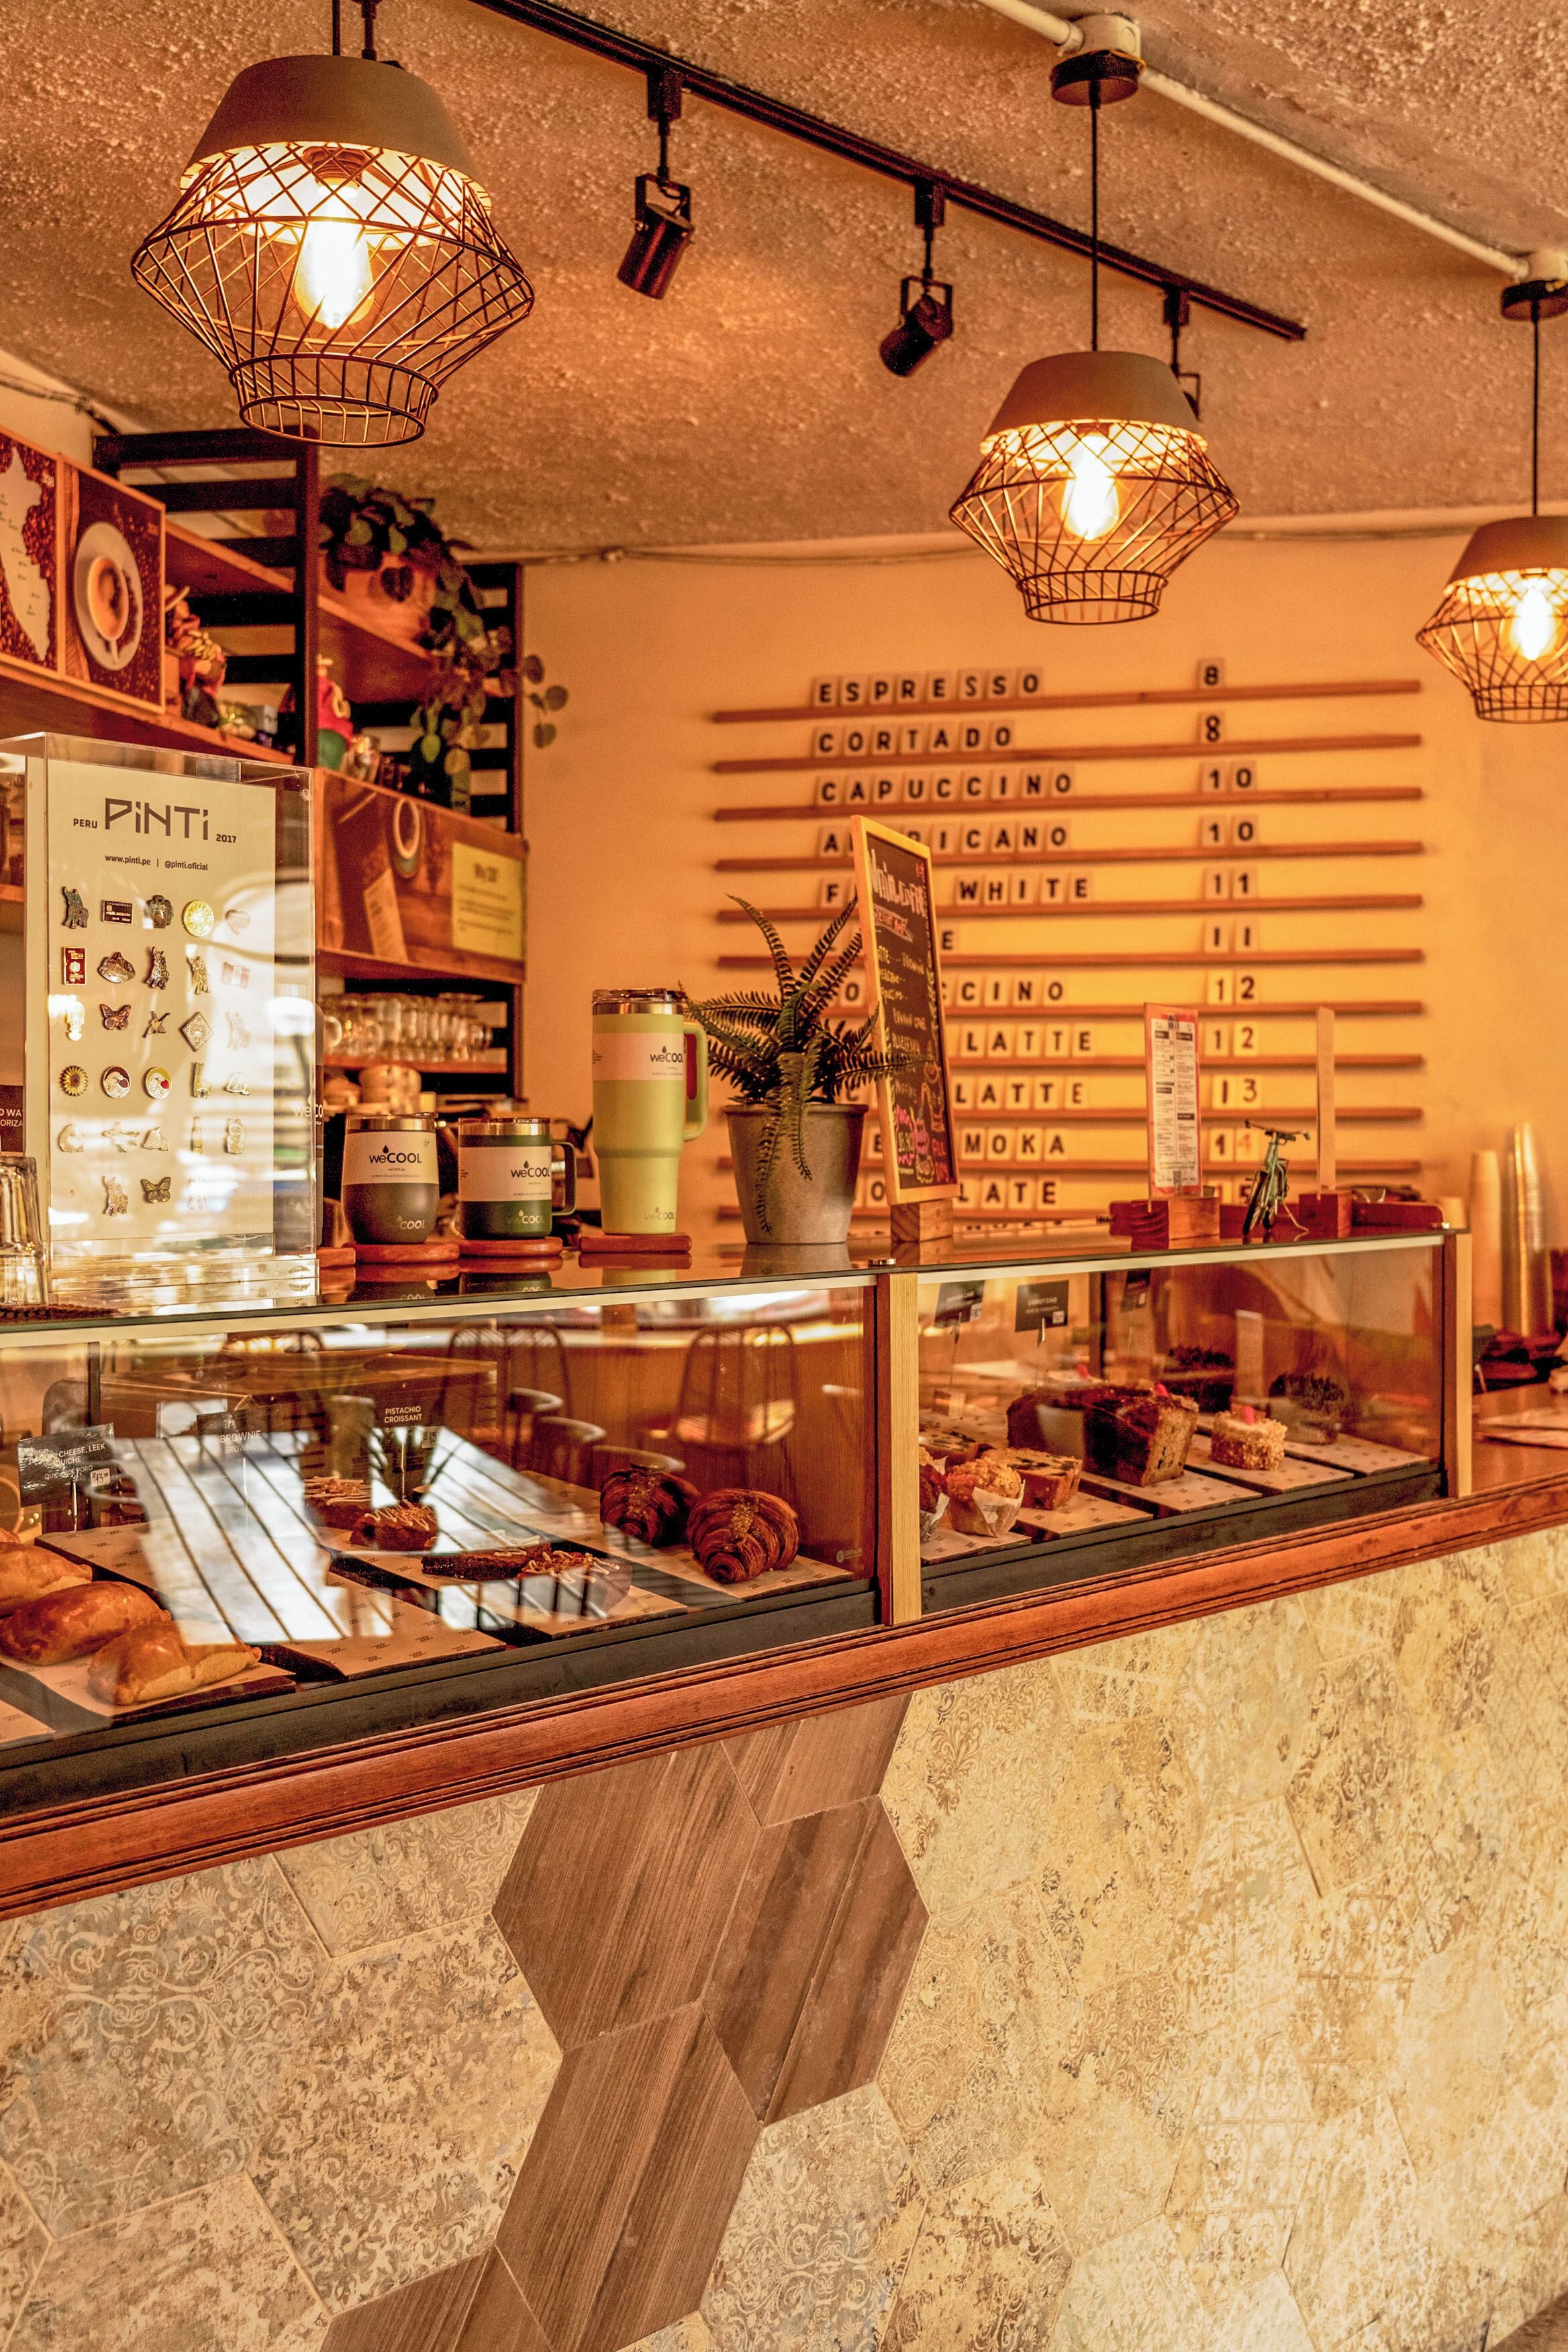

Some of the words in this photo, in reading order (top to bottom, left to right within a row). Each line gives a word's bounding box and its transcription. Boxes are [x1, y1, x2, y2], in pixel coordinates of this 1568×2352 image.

[819, 673, 1038, 702] ESPRESSO
[1204, 665, 1219, 685] 8
[818, 727, 1011, 752] CORTADO
[1206, 715, 1220, 742] 8
[822, 773, 1071, 801] CAPUCCINO
[1210, 768, 1252, 789] 10
[73, 818, 97, 829] PERU
[215, 834, 237, 844] 2017
[824, 826, 1066, 852] AICANO
[1210, 822, 1253, 841] 10
[105, 854, 151, 866] www.pinti.pe
[164, 860, 208, 871] @pinti.oficial
[959, 877, 1087, 900] WHITE
[1214, 873, 1248, 894] 11
[1216, 976, 1255, 1001] 12
[967, 1031, 1090, 1051] LATTE
[1214, 1026, 1253, 1050] 12
[956, 1083, 1082, 1104] LATTE
[1222, 1079, 1257, 1104] 13
[6, 1109, 23, 1117] WA
[965, 1134, 1064, 1155] MOKA
[1215, 1133, 1251, 1155] 14
[384, 1414, 423, 1423] CROISSANT
[385, 1406, 422, 1415] PISTACHIO
[220, 1430, 261, 1443] BROWNIE
[225, 1444, 258, 1453] BROWNIE
[58, 1448, 88, 1458] CHEESE,
[89, 1443, 106, 1452] LEEK
